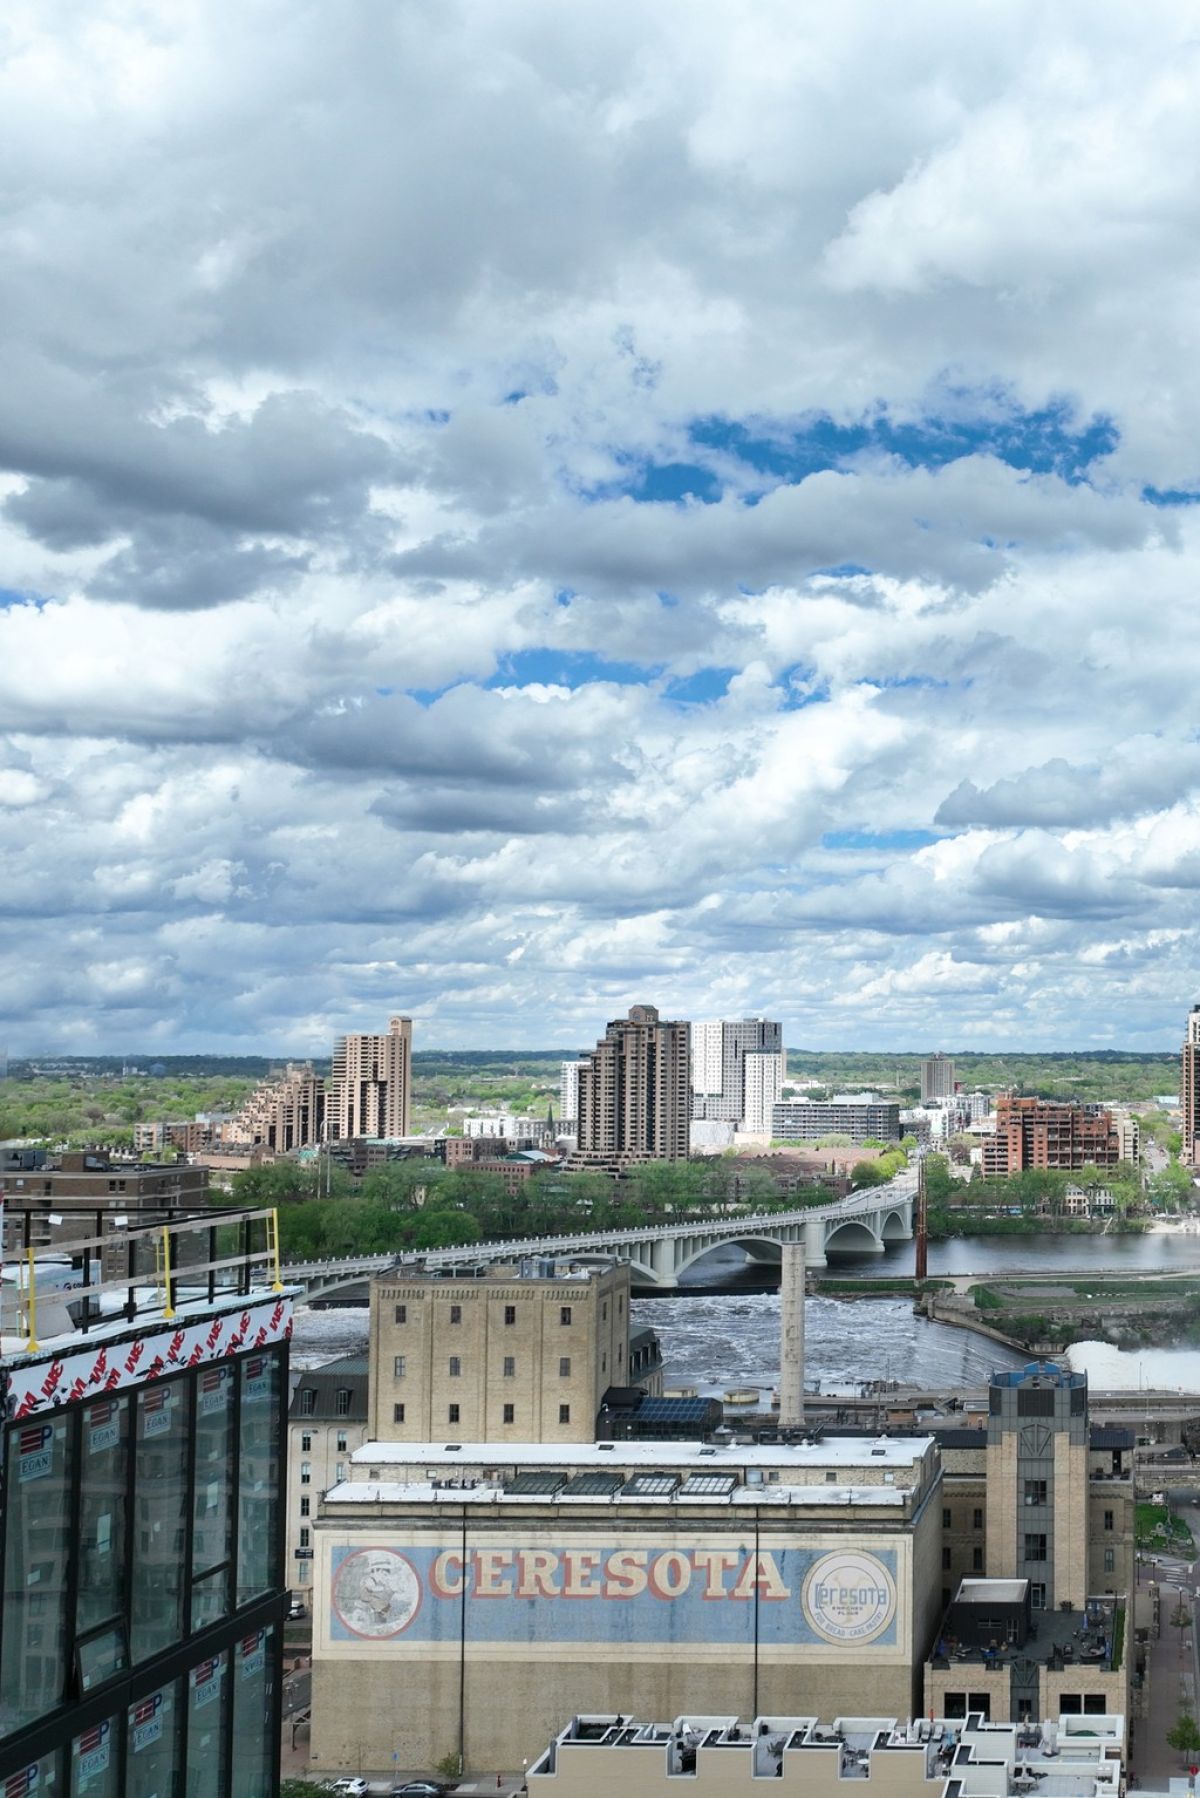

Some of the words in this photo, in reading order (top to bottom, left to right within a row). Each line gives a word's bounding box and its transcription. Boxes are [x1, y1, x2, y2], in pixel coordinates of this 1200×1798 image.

[124, 1339, 144, 1374] 3M
[41, 1359, 64, 1398] 3M
[93, 1430, 116, 1445] EGAN
[22, 1457, 48, 1473] EGAN
[430, 1549, 792, 1600] CERESOTA
[824, 1622, 846, 1637] BREAD
[849, 1628, 866, 1637] CAKE
